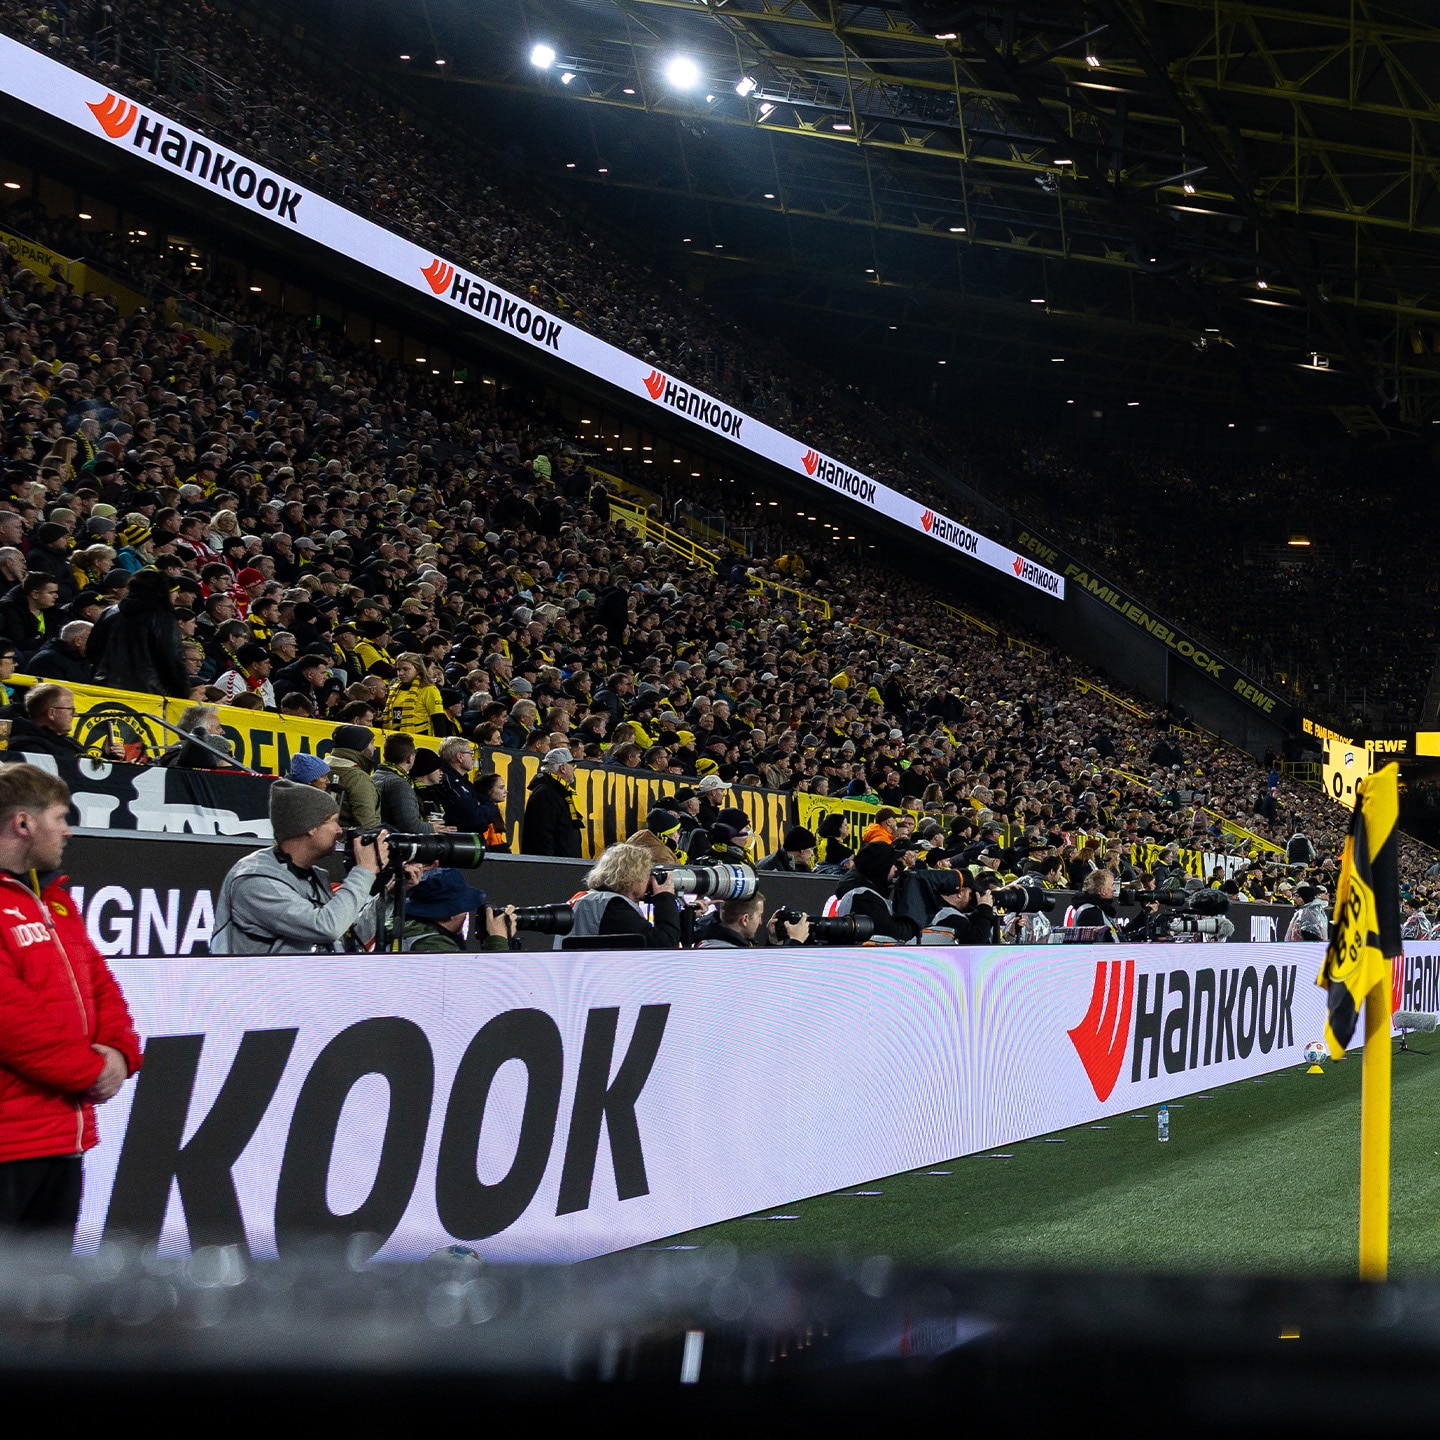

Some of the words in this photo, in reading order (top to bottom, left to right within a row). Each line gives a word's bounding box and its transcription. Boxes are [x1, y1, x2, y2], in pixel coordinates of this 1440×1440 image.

[21, 245, 53, 268] PARK
[1017, 531, 1058, 564] REWE
[1064, 562, 1226, 679] FAMILIENBLOCK
[1233, 678, 1277, 714] REWE
[1365, 740, 1407, 752] REWE
[101, 1003, 671, 1263] KOOK
